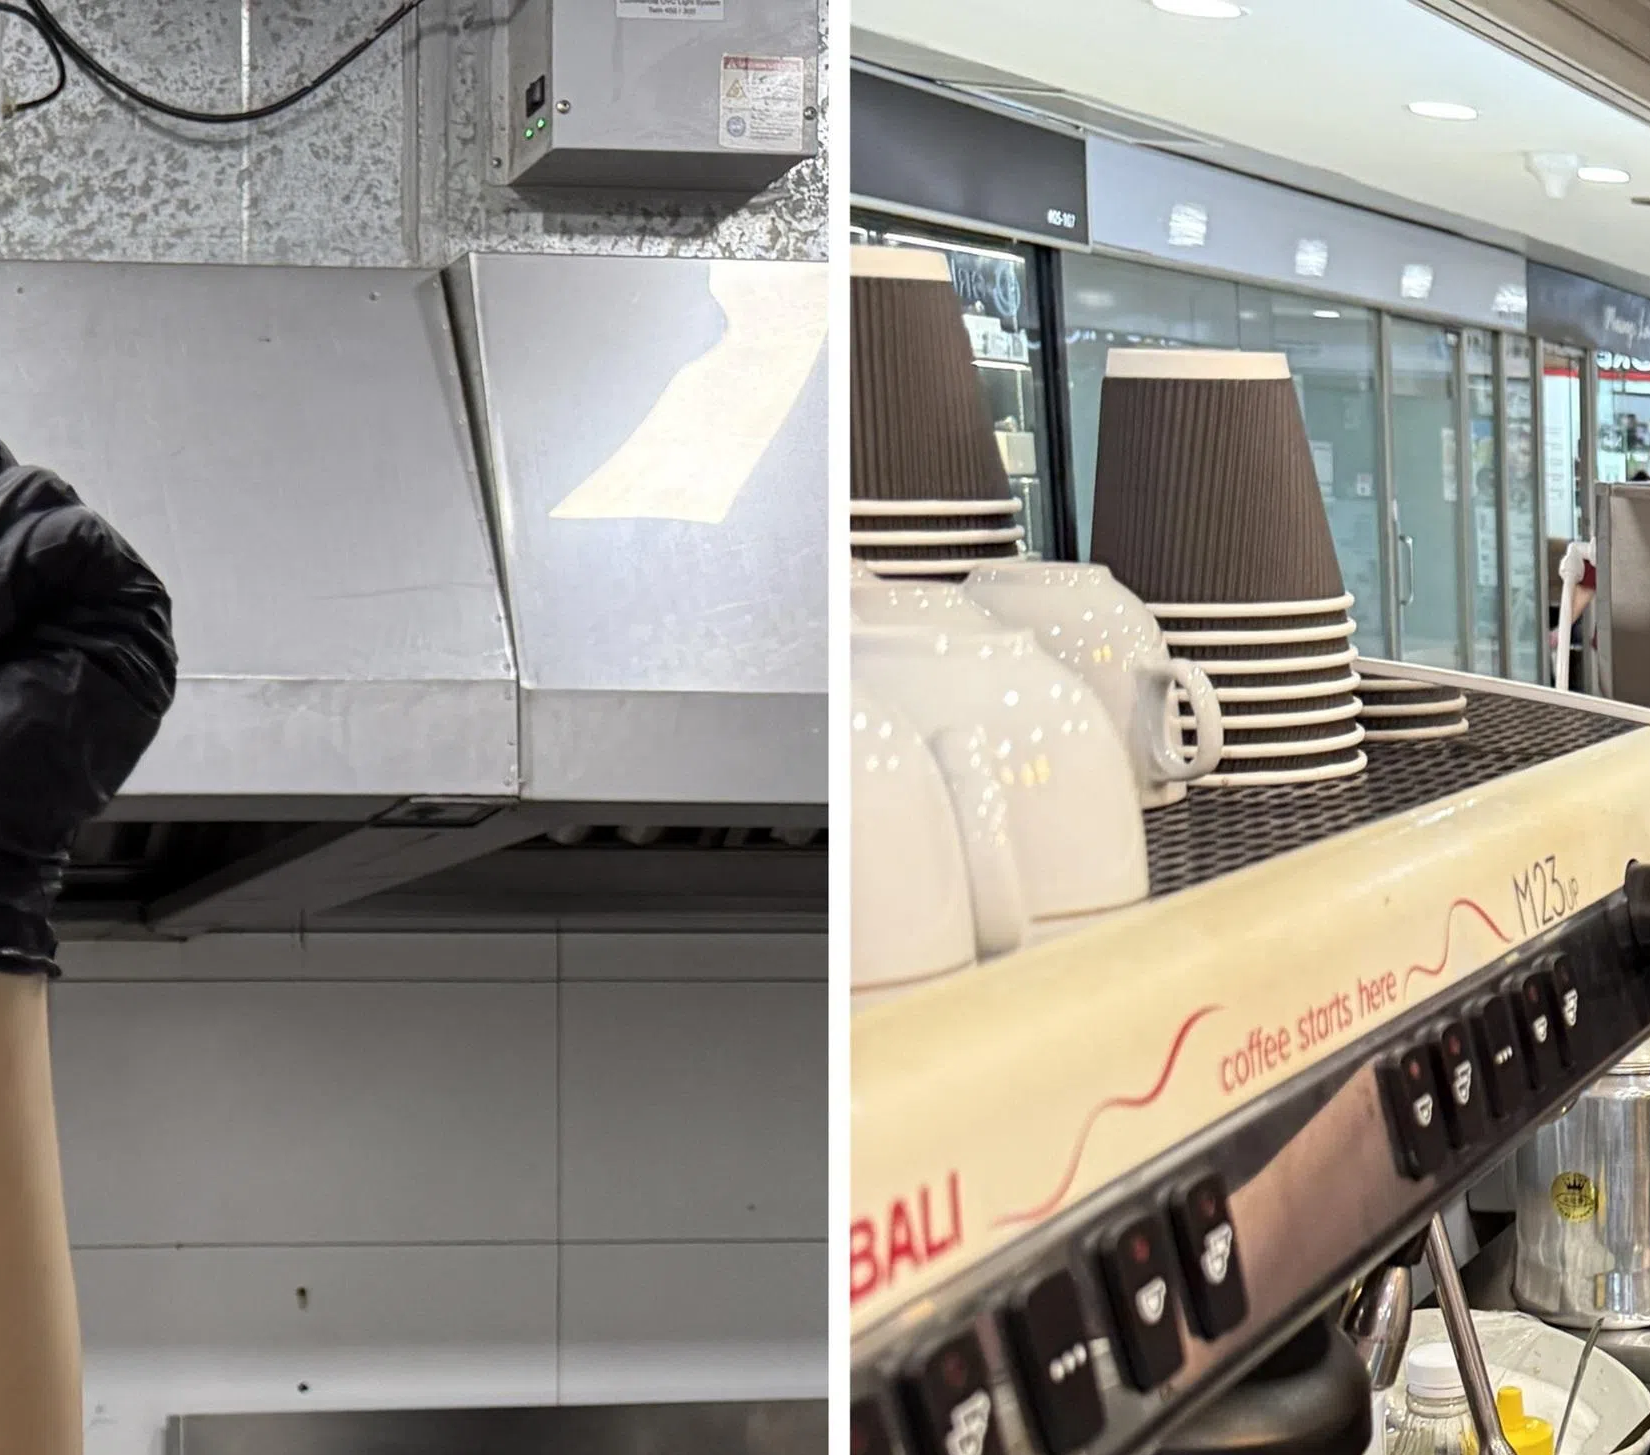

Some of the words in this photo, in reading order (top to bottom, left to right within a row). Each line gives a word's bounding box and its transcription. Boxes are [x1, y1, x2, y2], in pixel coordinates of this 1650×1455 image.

[1219, 1024, 1291, 1096] coffee
[1297, 989, 1353, 1051] starts
[1357, 970, 1398, 1019] here
